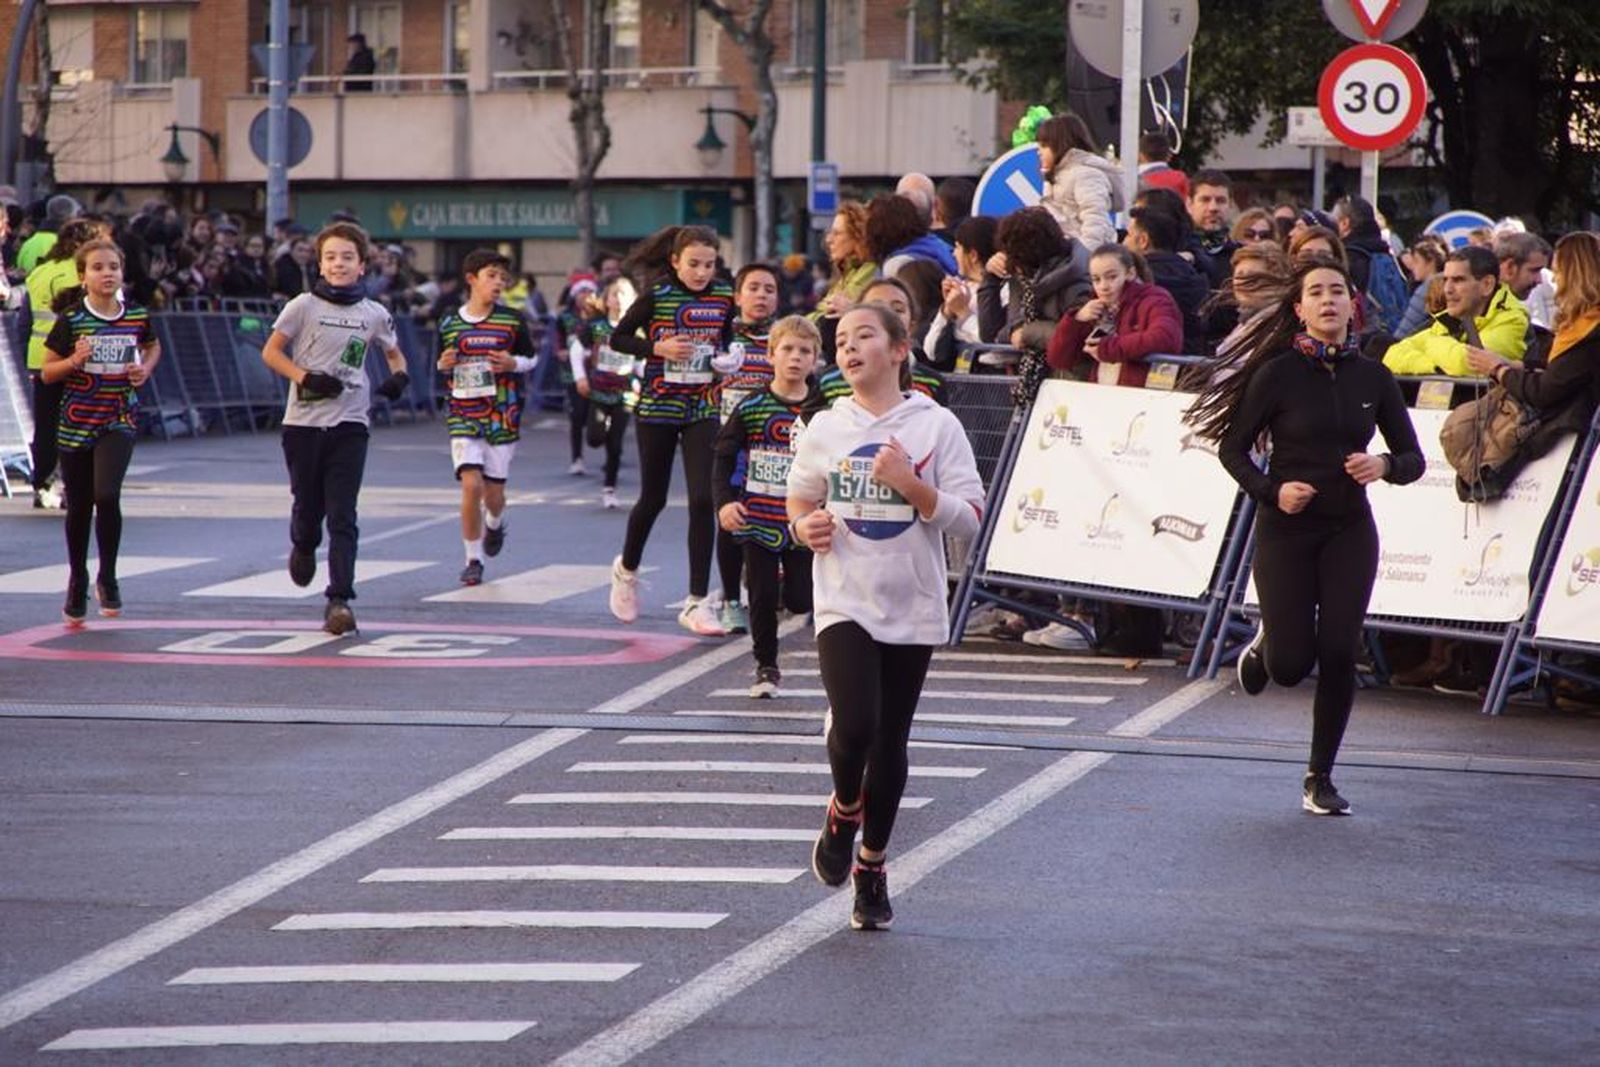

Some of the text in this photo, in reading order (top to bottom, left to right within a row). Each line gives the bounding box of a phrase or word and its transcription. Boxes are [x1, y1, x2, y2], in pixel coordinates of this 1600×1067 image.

[1343, 81, 1400, 115] 30
[412, 202, 445, 231] CAJA
[448, 202, 494, 226] RURAL
[518, 202, 610, 226] SALAMACA
[92, 344, 126, 362] 5897
[1050, 425, 1083, 440] SETEL
[1024, 507, 1060, 524] SETEL
[1385, 566, 1427, 582] Salamanca
